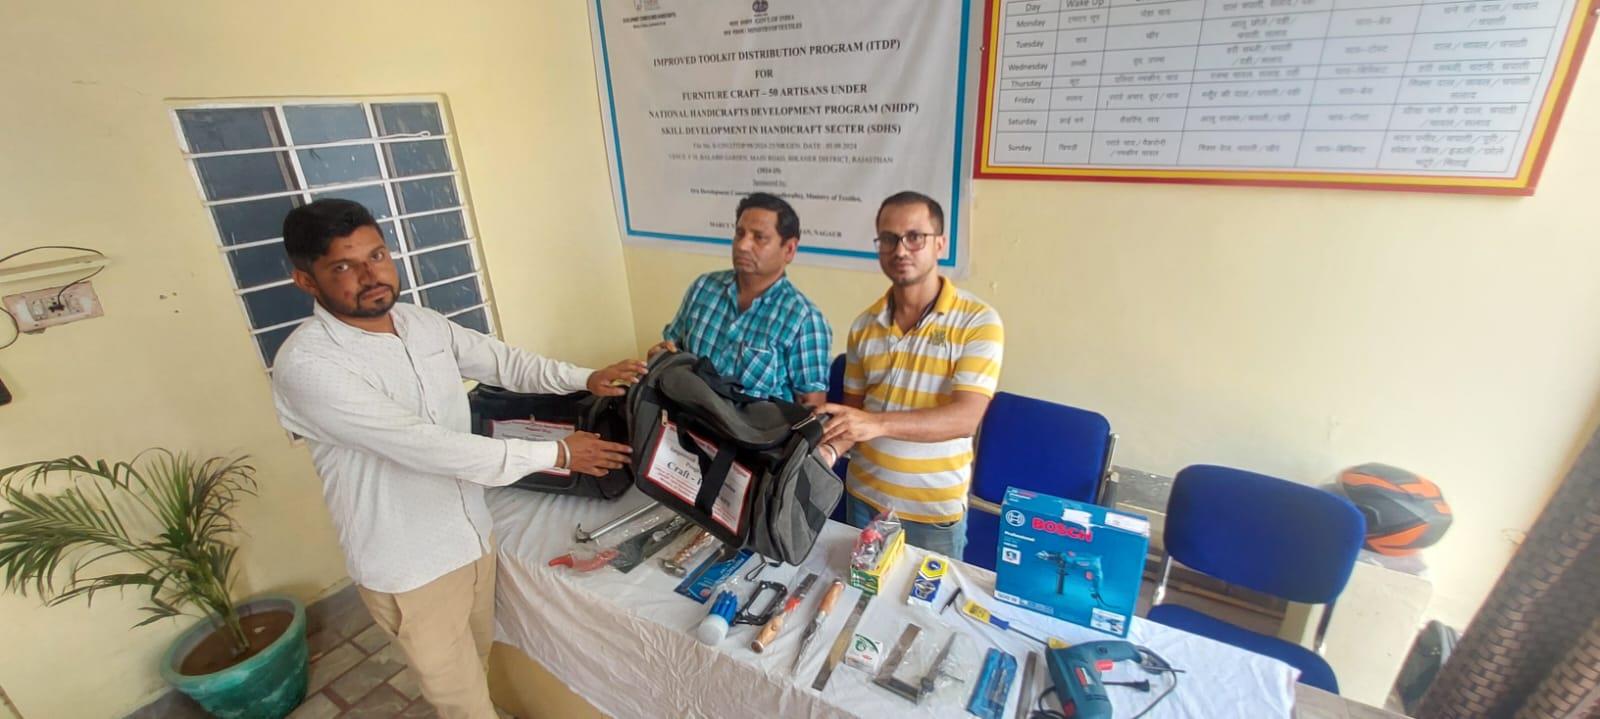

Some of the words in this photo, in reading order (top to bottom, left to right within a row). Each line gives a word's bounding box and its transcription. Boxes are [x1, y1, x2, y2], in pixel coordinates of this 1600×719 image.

[1025, 3, 1041, 13] Day
[1016, 19, 1046, 28] Monday
[1015, 40, 1045, 49] Tuesday
[653, 55, 697, 68] IMPROVED
[698, 53, 737, 65] TOOLKIT
[738, 46, 807, 60] DISTRIBUTION
[809, 41, 863, 56] PROGRAM
[866, 39, 901, 53] (ITDP)
[1008, 62, 1048, 71] Wednesday
[755, 69, 774, 79] FOR
[1011, 80, 1042, 88] Thursday
[682, 90, 728, 101] FURNITURE
[730, 89, 760, 99] CRAFT
[769, 88, 778, 97] 50
[780, 85, 829, 97] ARTISANS
[831, 83, 868, 95] UNDER
[1014, 96, 1036, 104] Friday
[649, 110, 688, 119] NATIONAL
[690, 108, 749, 118] HANDICRAFTS
[750, 105, 821, 117] DEVELOPMENT
[824, 103, 878, 115] PROGRAM
[881, 102, 919, 114] (NHDP)
[1008, 118, 1037, 126] Saturday
[661, 125, 683, 135] SKILL
[685, 125, 747, 135] DEVELOPMENT
[749, 125, 758, 135] IN
[760, 124, 822, 135] HANDICRAFT
[823, 124, 864, 135] SECTER
[867, 123, 901, 135] (SDHS)
[1007, 143, 1032, 152] Sunday
[667, 461, 690, 479] Craft
[1032, 517, 1093, 543] BOSCH
